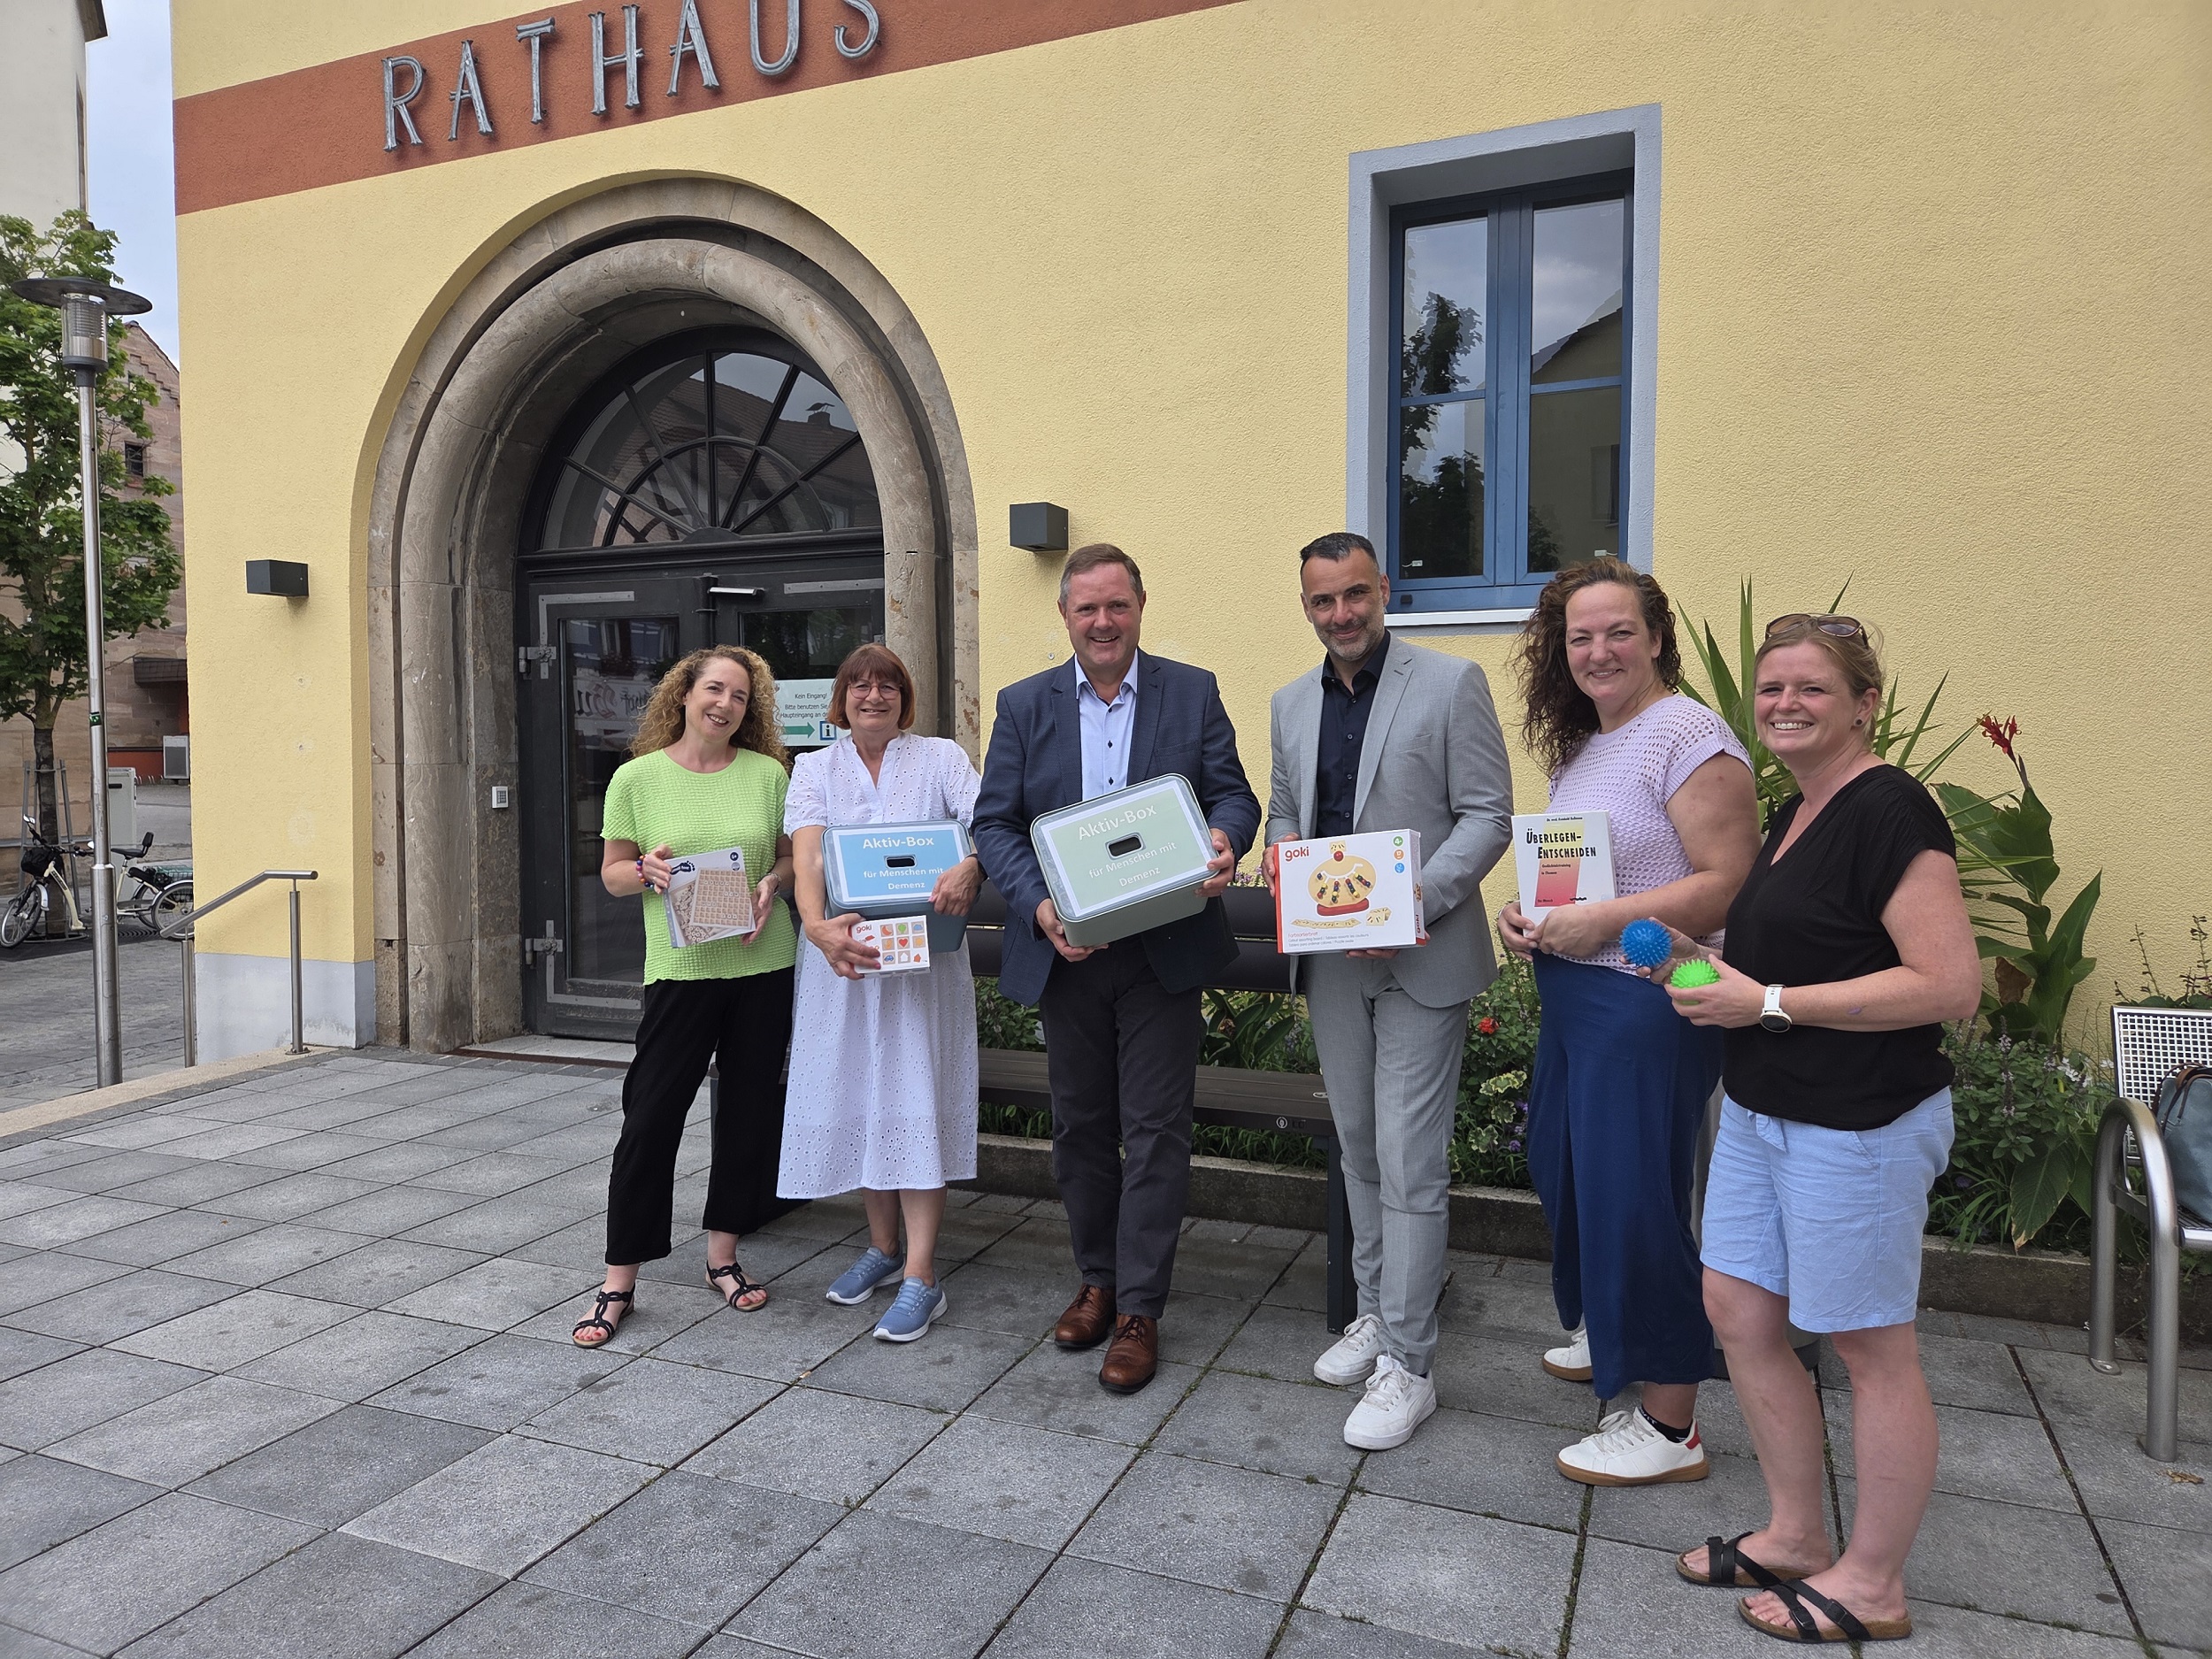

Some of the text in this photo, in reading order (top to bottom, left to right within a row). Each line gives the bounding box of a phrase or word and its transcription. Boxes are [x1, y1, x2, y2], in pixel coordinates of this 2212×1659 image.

[381, 0, 881, 152] RATHAUS
[1078, 804, 1157, 841] Aktiv-Box
[863, 836, 935, 849] Aktiv-Box
[1088, 841, 1177, 879] für Menschen mit
[1285, 846, 1310, 862] goki
[863, 870, 877, 879] für
[879, 868, 926, 878] Menschen
[1118, 866, 1161, 887] Demenz
[887, 881, 926, 890] Demenz
[856, 924, 872, 934] goki
